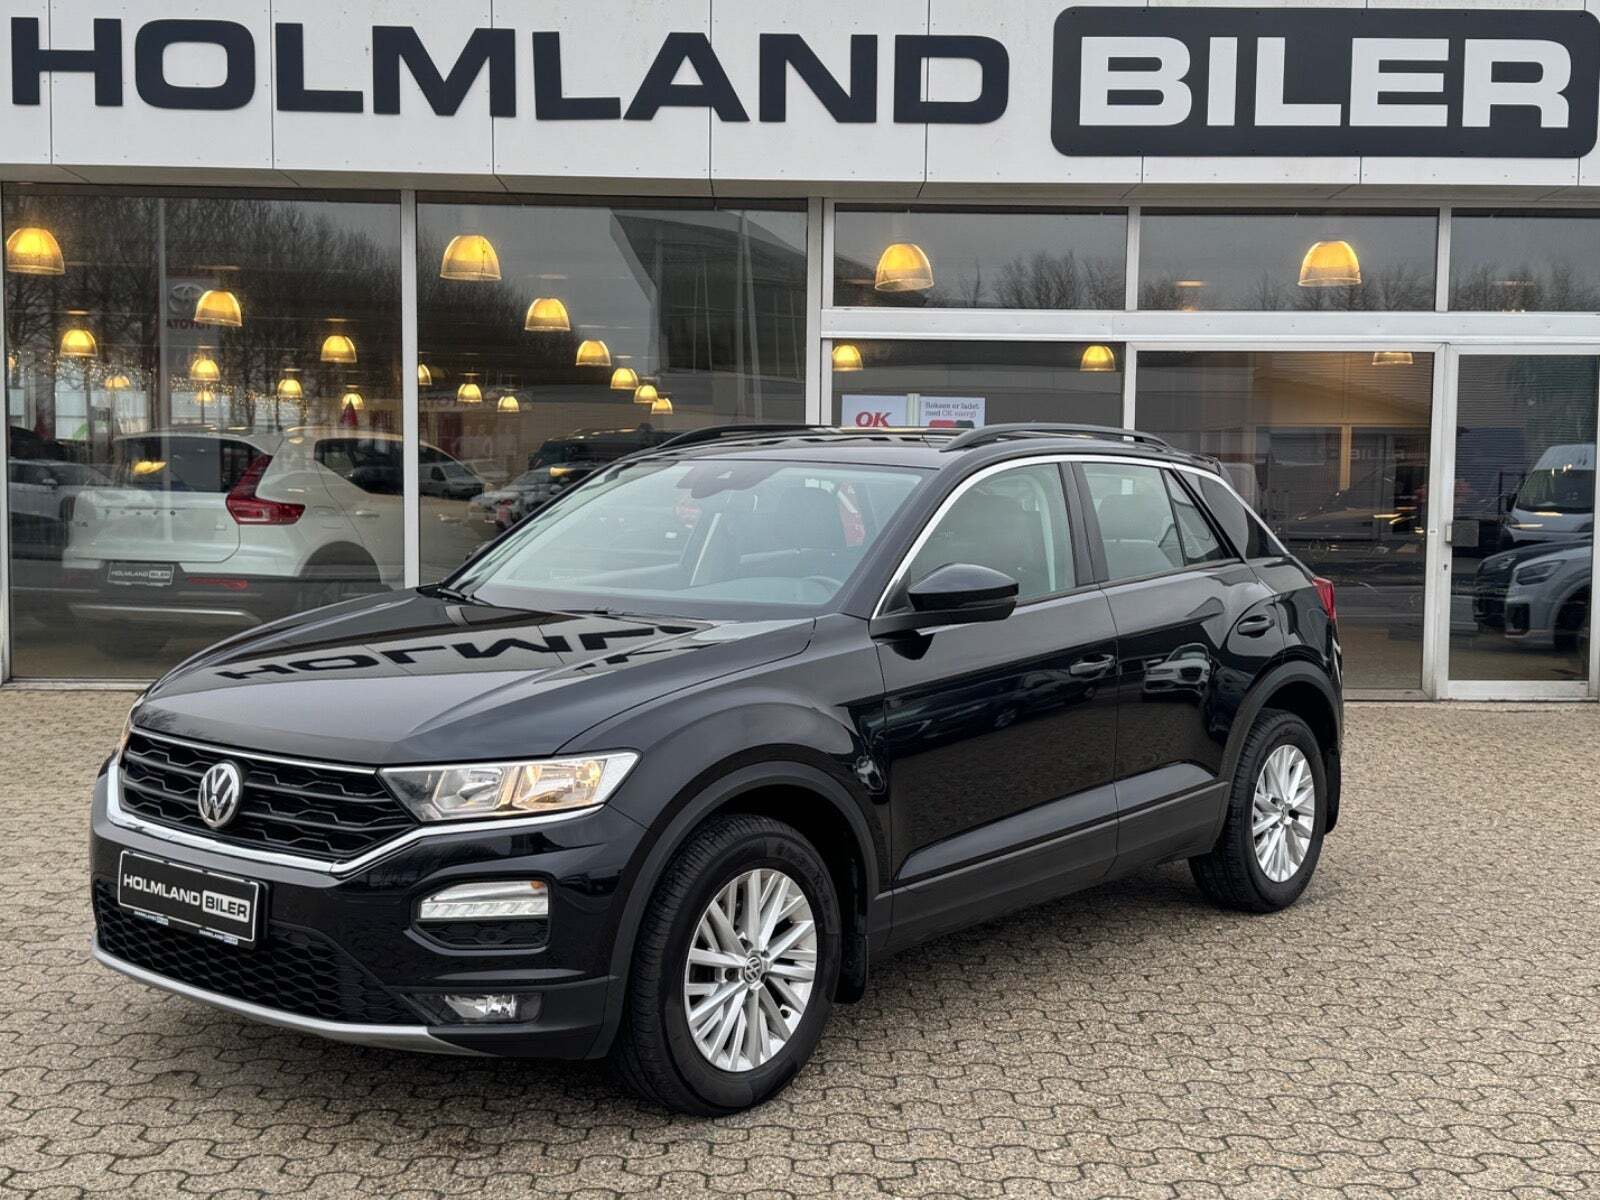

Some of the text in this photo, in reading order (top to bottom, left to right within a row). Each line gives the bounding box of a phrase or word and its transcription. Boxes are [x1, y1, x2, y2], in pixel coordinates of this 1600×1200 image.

[11, 17, 1572, 129] HOLMLAND BILER
[855, 411, 892, 428] OK
[123, 873, 248, 918] HOLMLAND BILER
